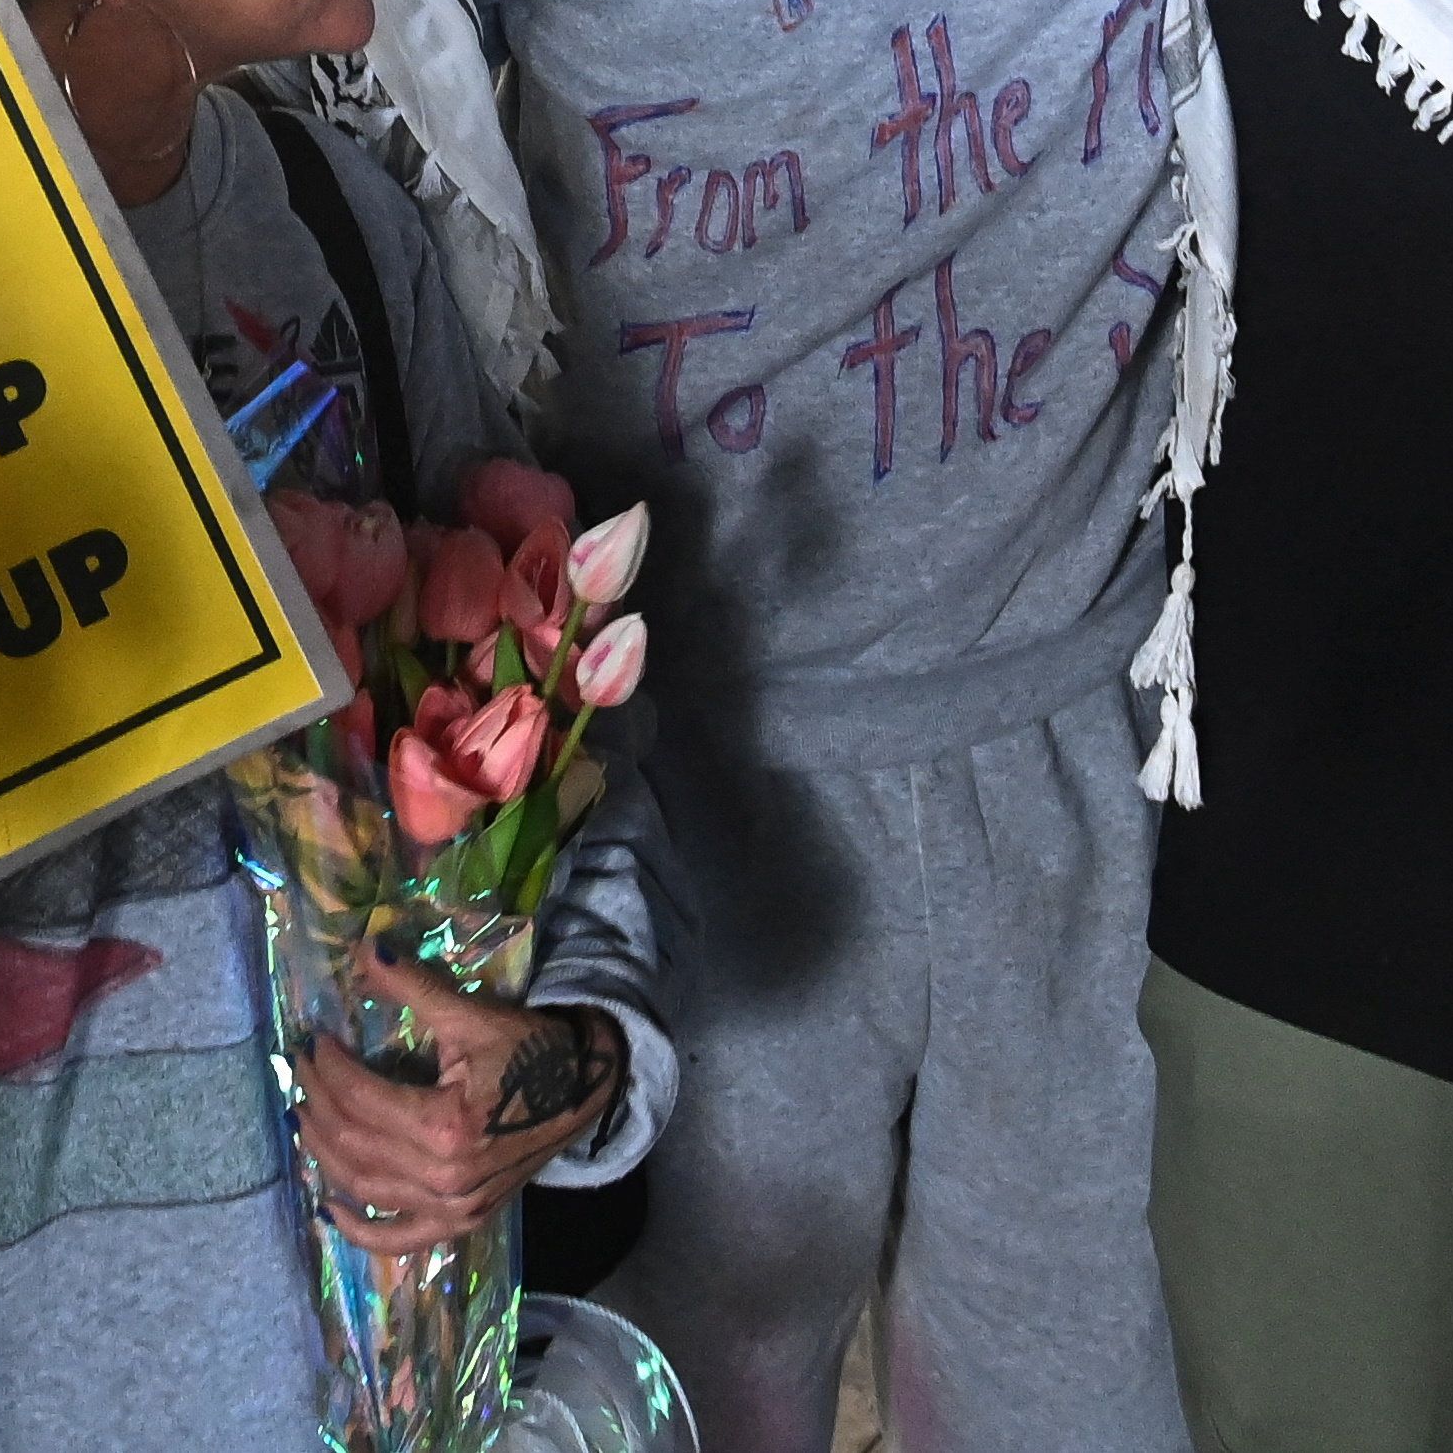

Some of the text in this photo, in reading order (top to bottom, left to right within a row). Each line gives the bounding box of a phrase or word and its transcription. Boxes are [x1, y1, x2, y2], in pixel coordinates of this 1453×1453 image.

[588, 97, 811, 267] From
[869, 12, 1038, 230] the
[619, 303, 767, 462] To
[838, 249, 1052, 484] the
